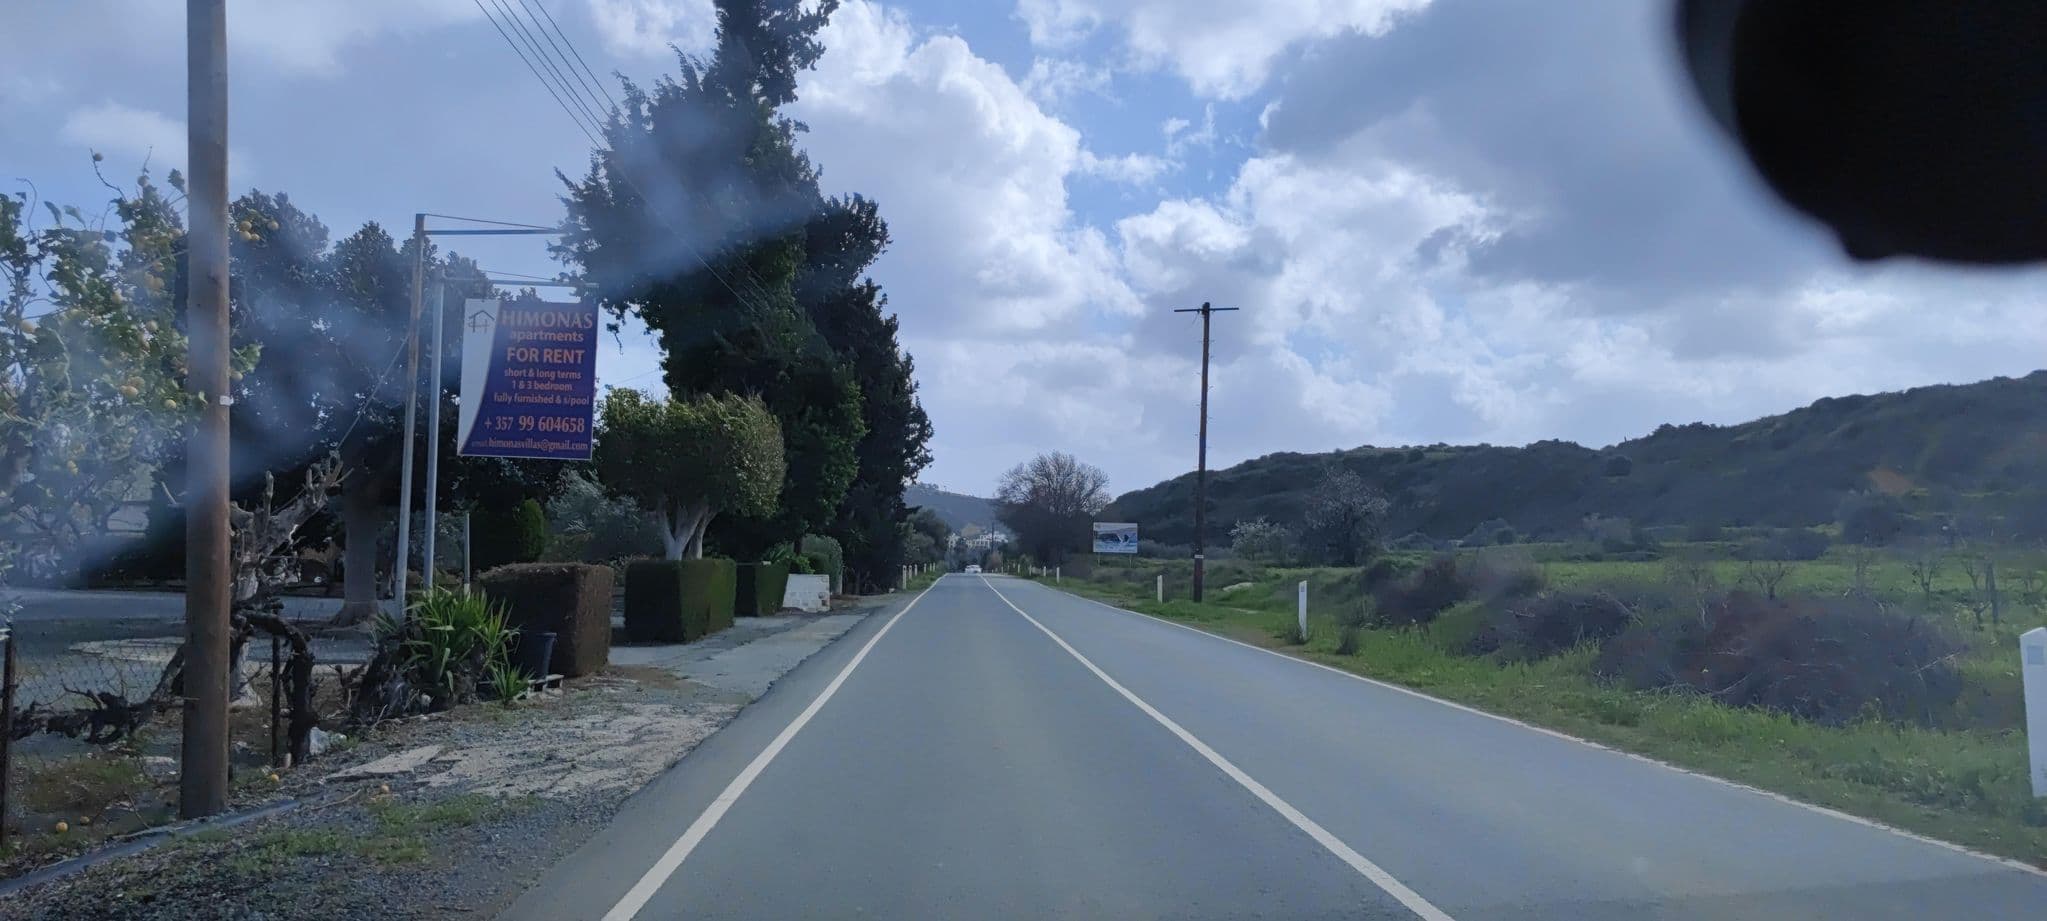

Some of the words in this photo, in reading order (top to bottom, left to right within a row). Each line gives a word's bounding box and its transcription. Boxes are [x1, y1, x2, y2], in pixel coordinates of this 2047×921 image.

[502, 310, 593, 328] HIMONAS
[510, 330, 584, 342] apartments
[507, 347, 539, 362] FOR
[543, 348, 585, 364] RENT
[504, 368, 526, 377] short
[527, 369, 534, 377] &
[536, 369, 556, 379] long
[558, 370, 582, 379] terms
[518, 382, 526, 390] &
[534, 381, 572, 391] bedroom
[494, 392, 512, 404] fully
[514, 393, 554, 404] furnished
[556, 395, 564, 404] &
[495, 416, 514, 430] 357
[518, 416, 534, 430] 99
[538, 416, 584, 432] 604658
